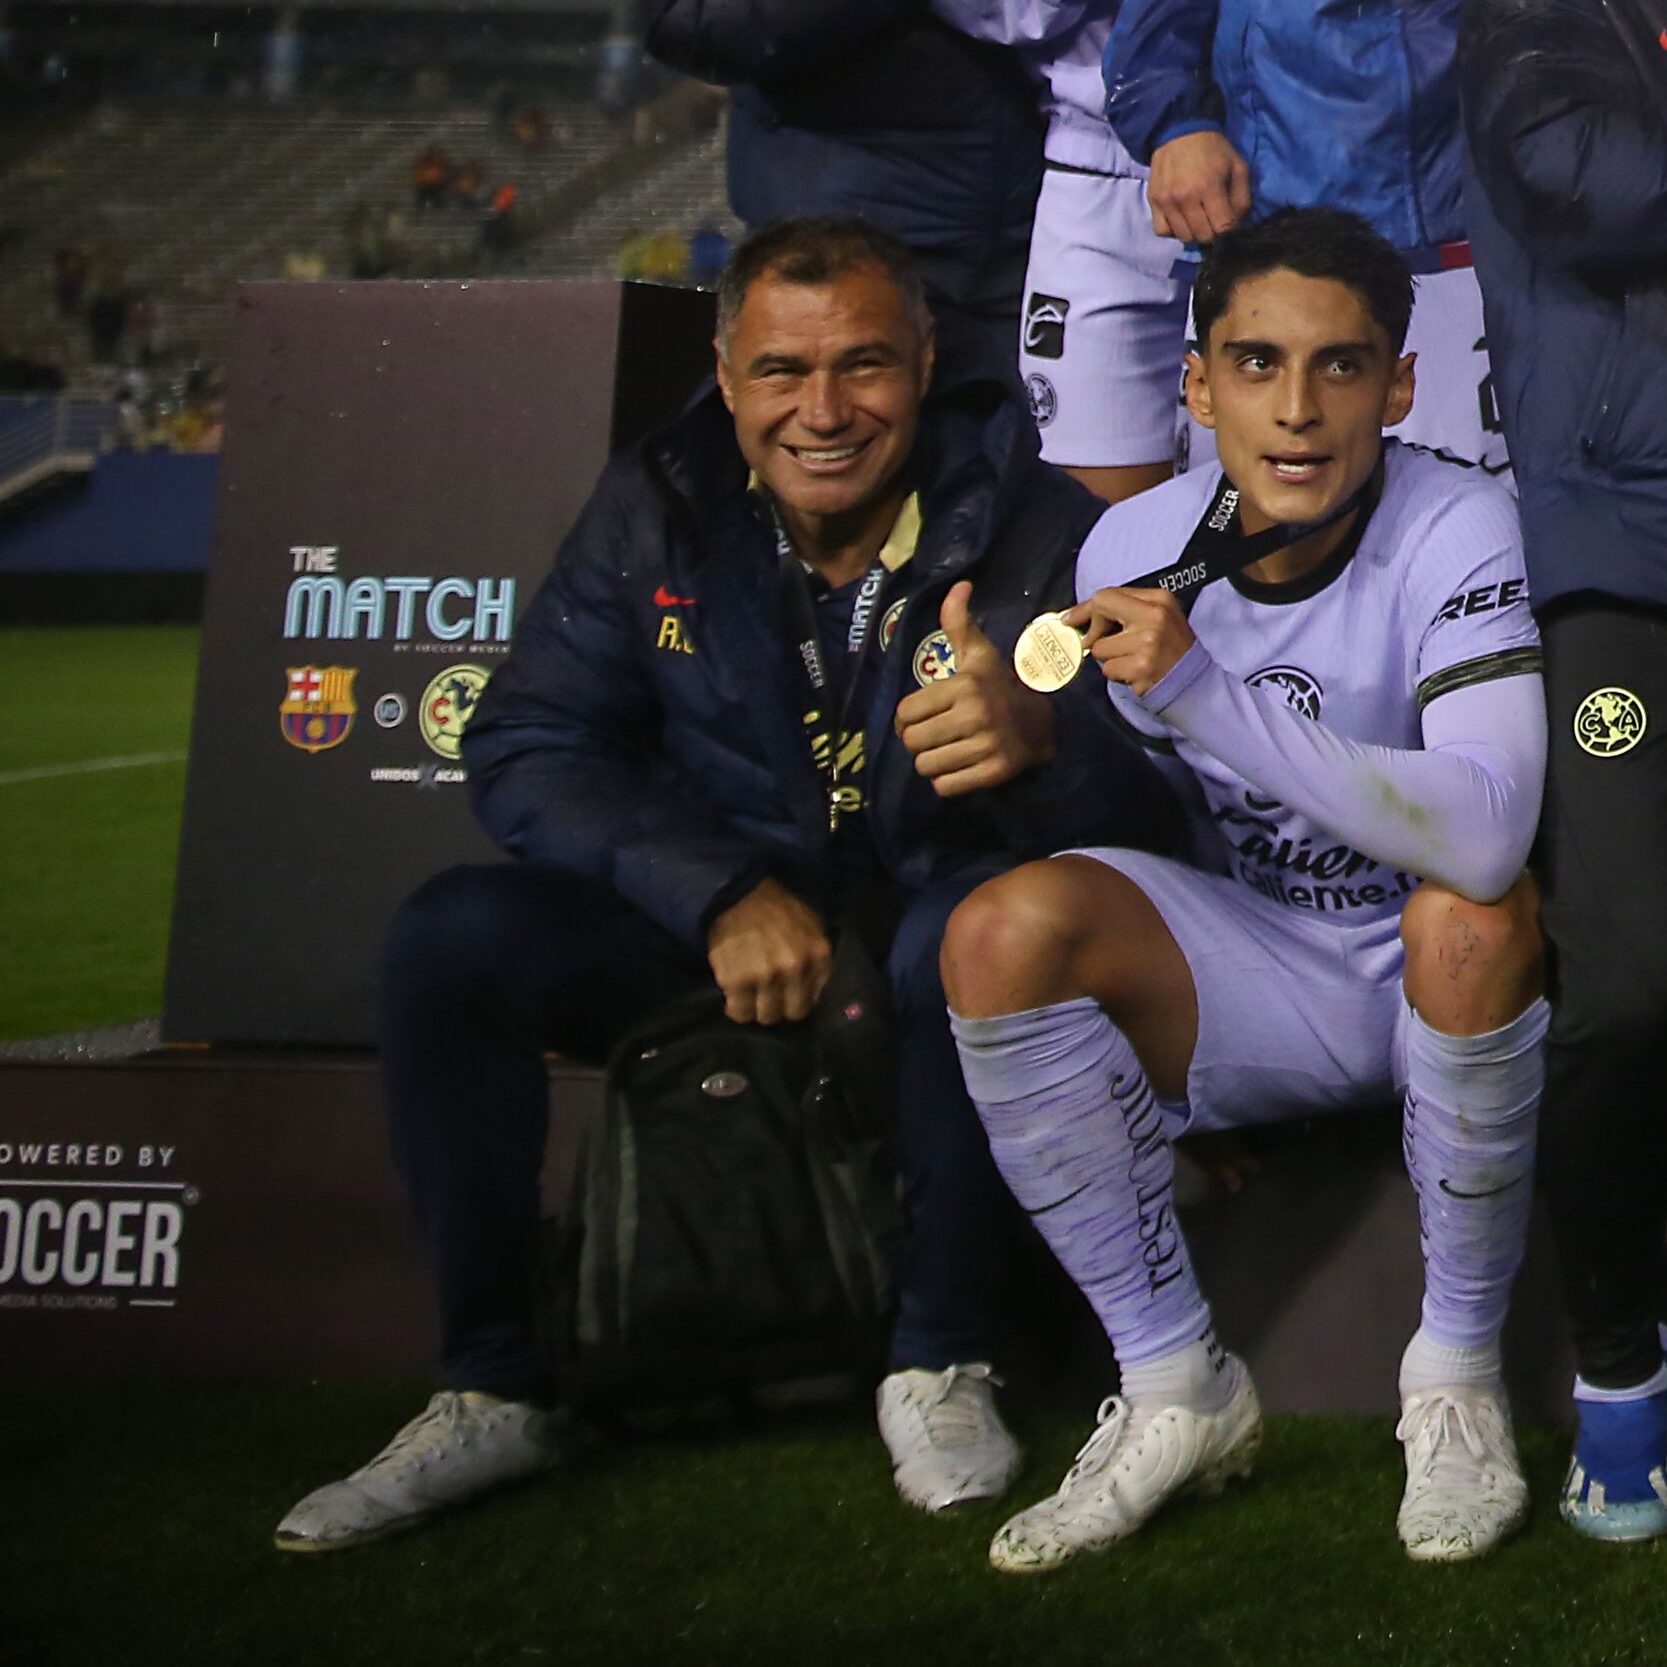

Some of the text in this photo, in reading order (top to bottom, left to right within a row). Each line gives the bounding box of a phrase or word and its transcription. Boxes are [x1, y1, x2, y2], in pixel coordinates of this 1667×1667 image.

[1208, 488, 1240, 532] SOCCER
[290, 546, 338, 573] THE
[283, 576, 516, 642] MATCH
[849, 568, 885, 645] MATCH
[800, 639, 825, 689] SOCCER
[0, 1144, 177, 1167] OWERED BY
[0, 1199, 183, 1287] OCCER
